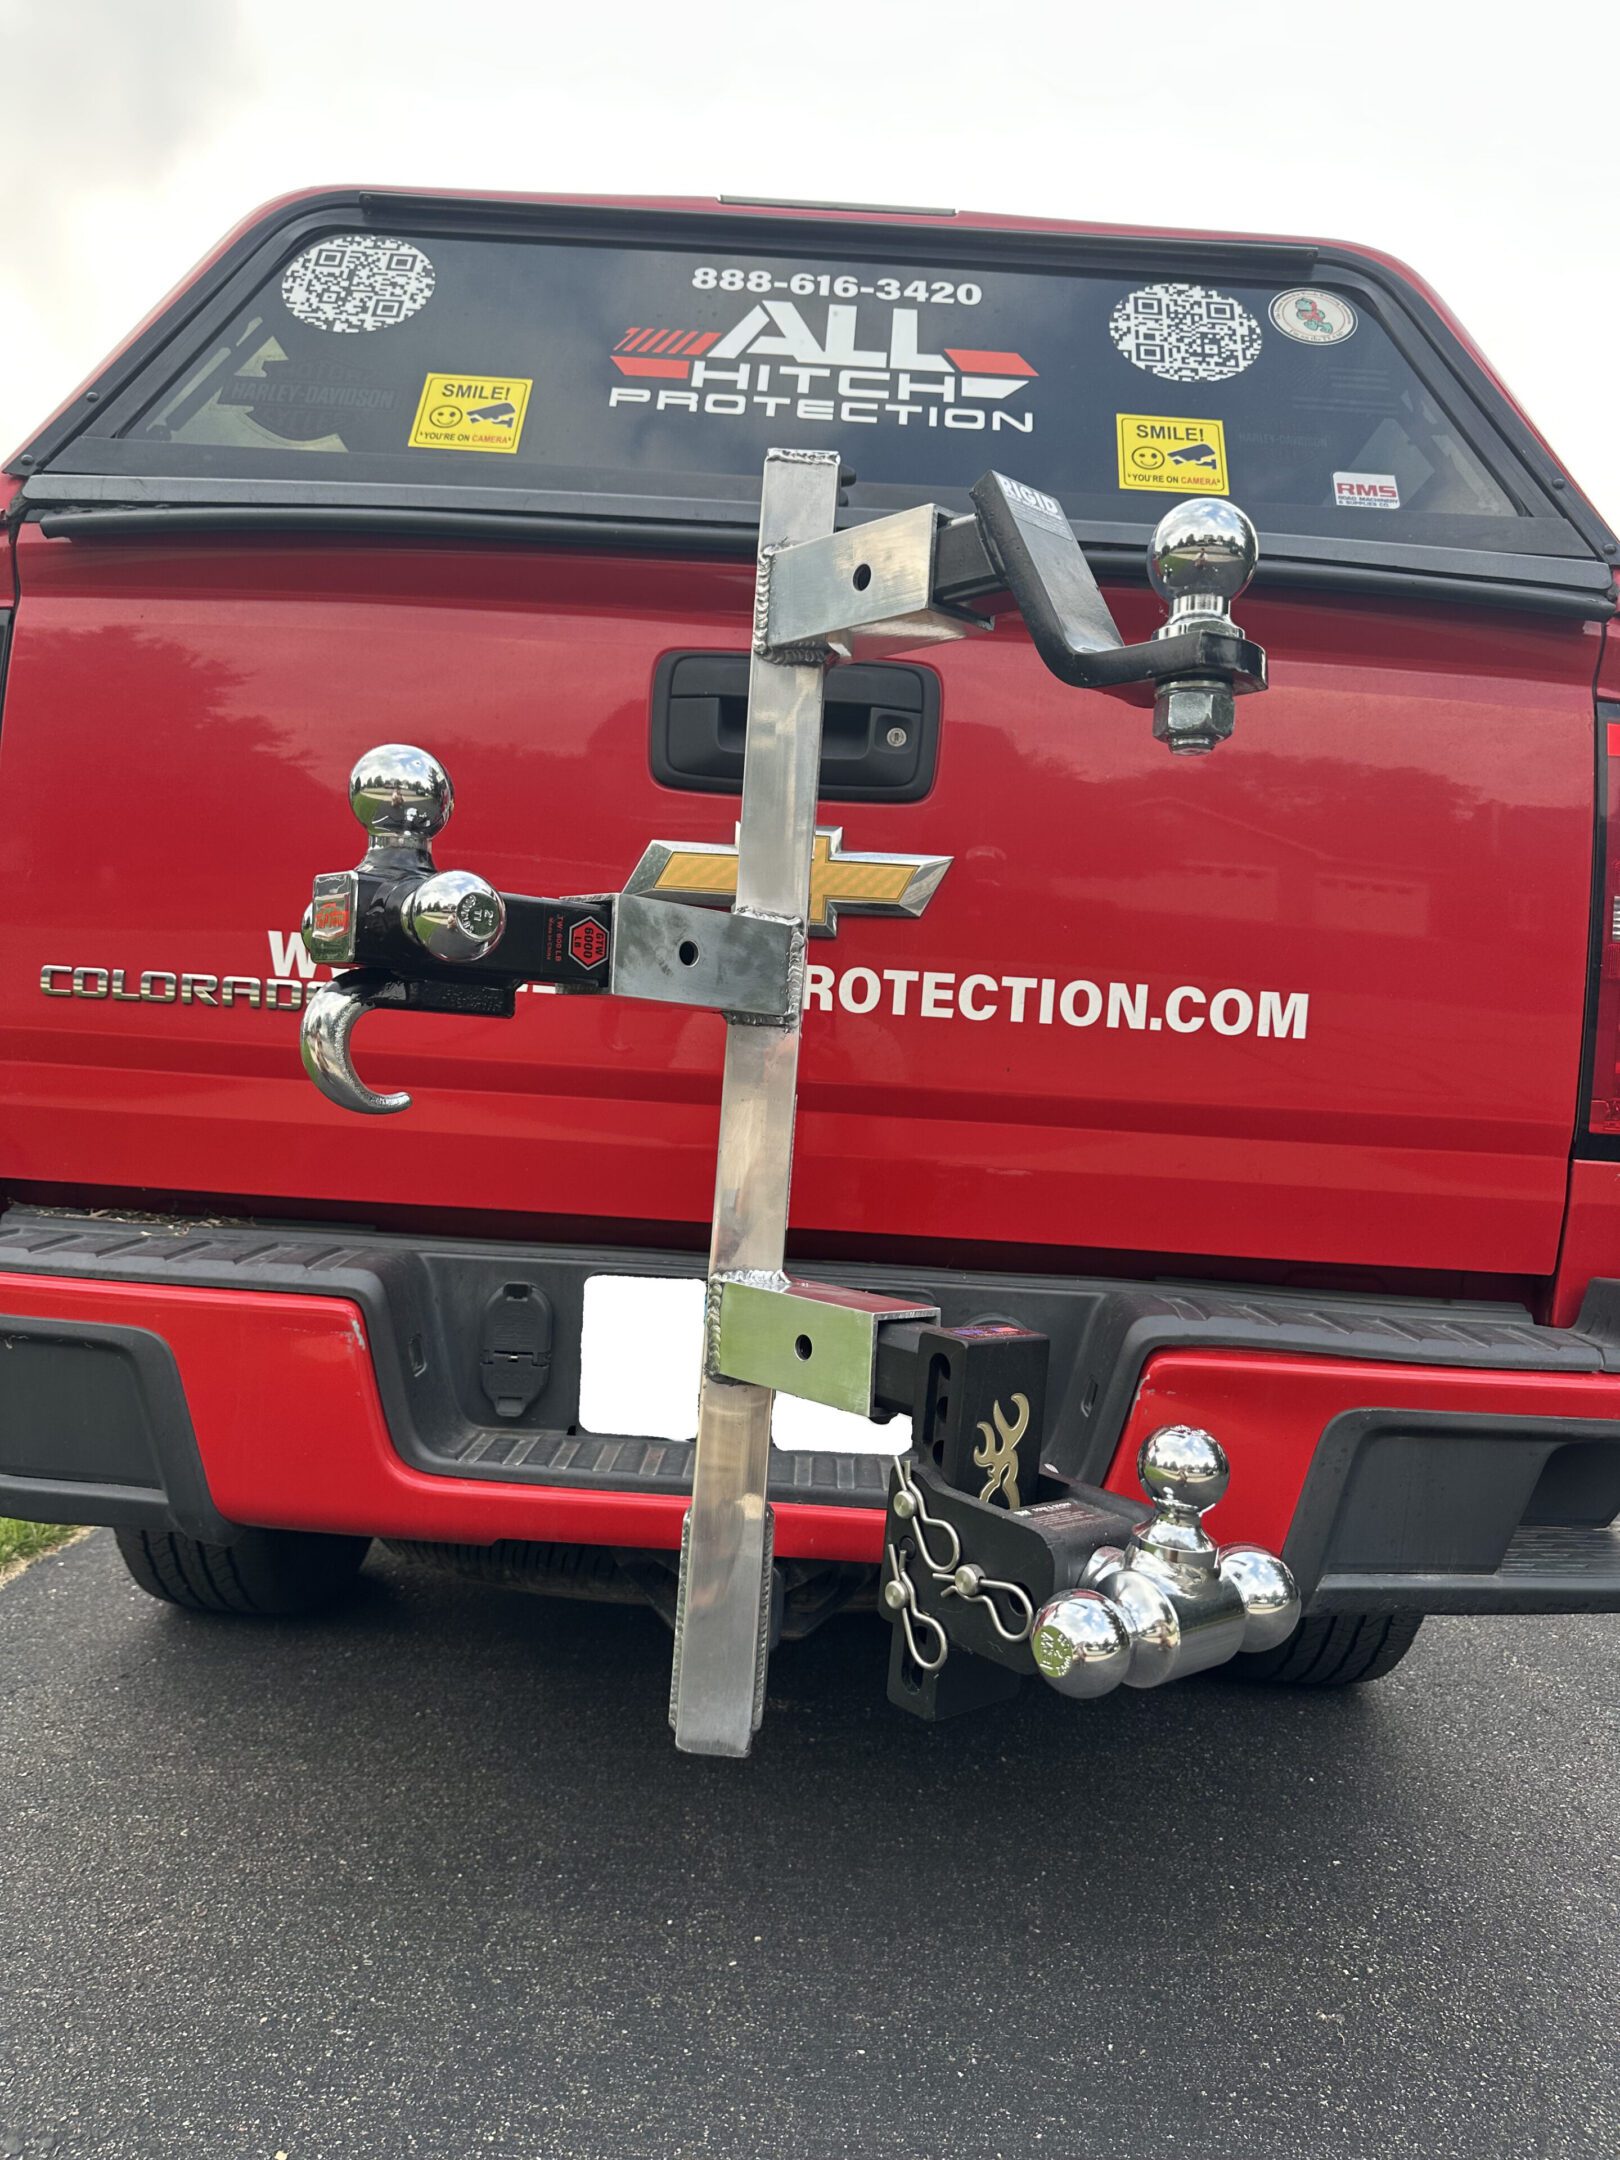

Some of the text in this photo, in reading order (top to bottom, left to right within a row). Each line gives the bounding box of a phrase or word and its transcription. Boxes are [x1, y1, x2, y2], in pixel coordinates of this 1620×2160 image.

[692, 267, 982, 306] 888-616-3420
[707, 299, 956, 373] ALL
[442, 383, 511, 401] SMILE!
[690, 360, 956, 403] HITCH
[231, 382, 396, 410] HARLEY-DAVIDSON
[608, 387, 1034, 433] PROTECTION
[457, 433, 470, 442] ON
[1136, 424, 1204, 442] SMILE!
[1166, 475, 1179, 484] ON
[1337, 482, 1397, 498] RMS
[999, 477, 1059, 514] RIGID
[574, 936, 582, 948] LB
[583, 927, 594, 958] 6000
[595, 932, 604, 955] GTW
